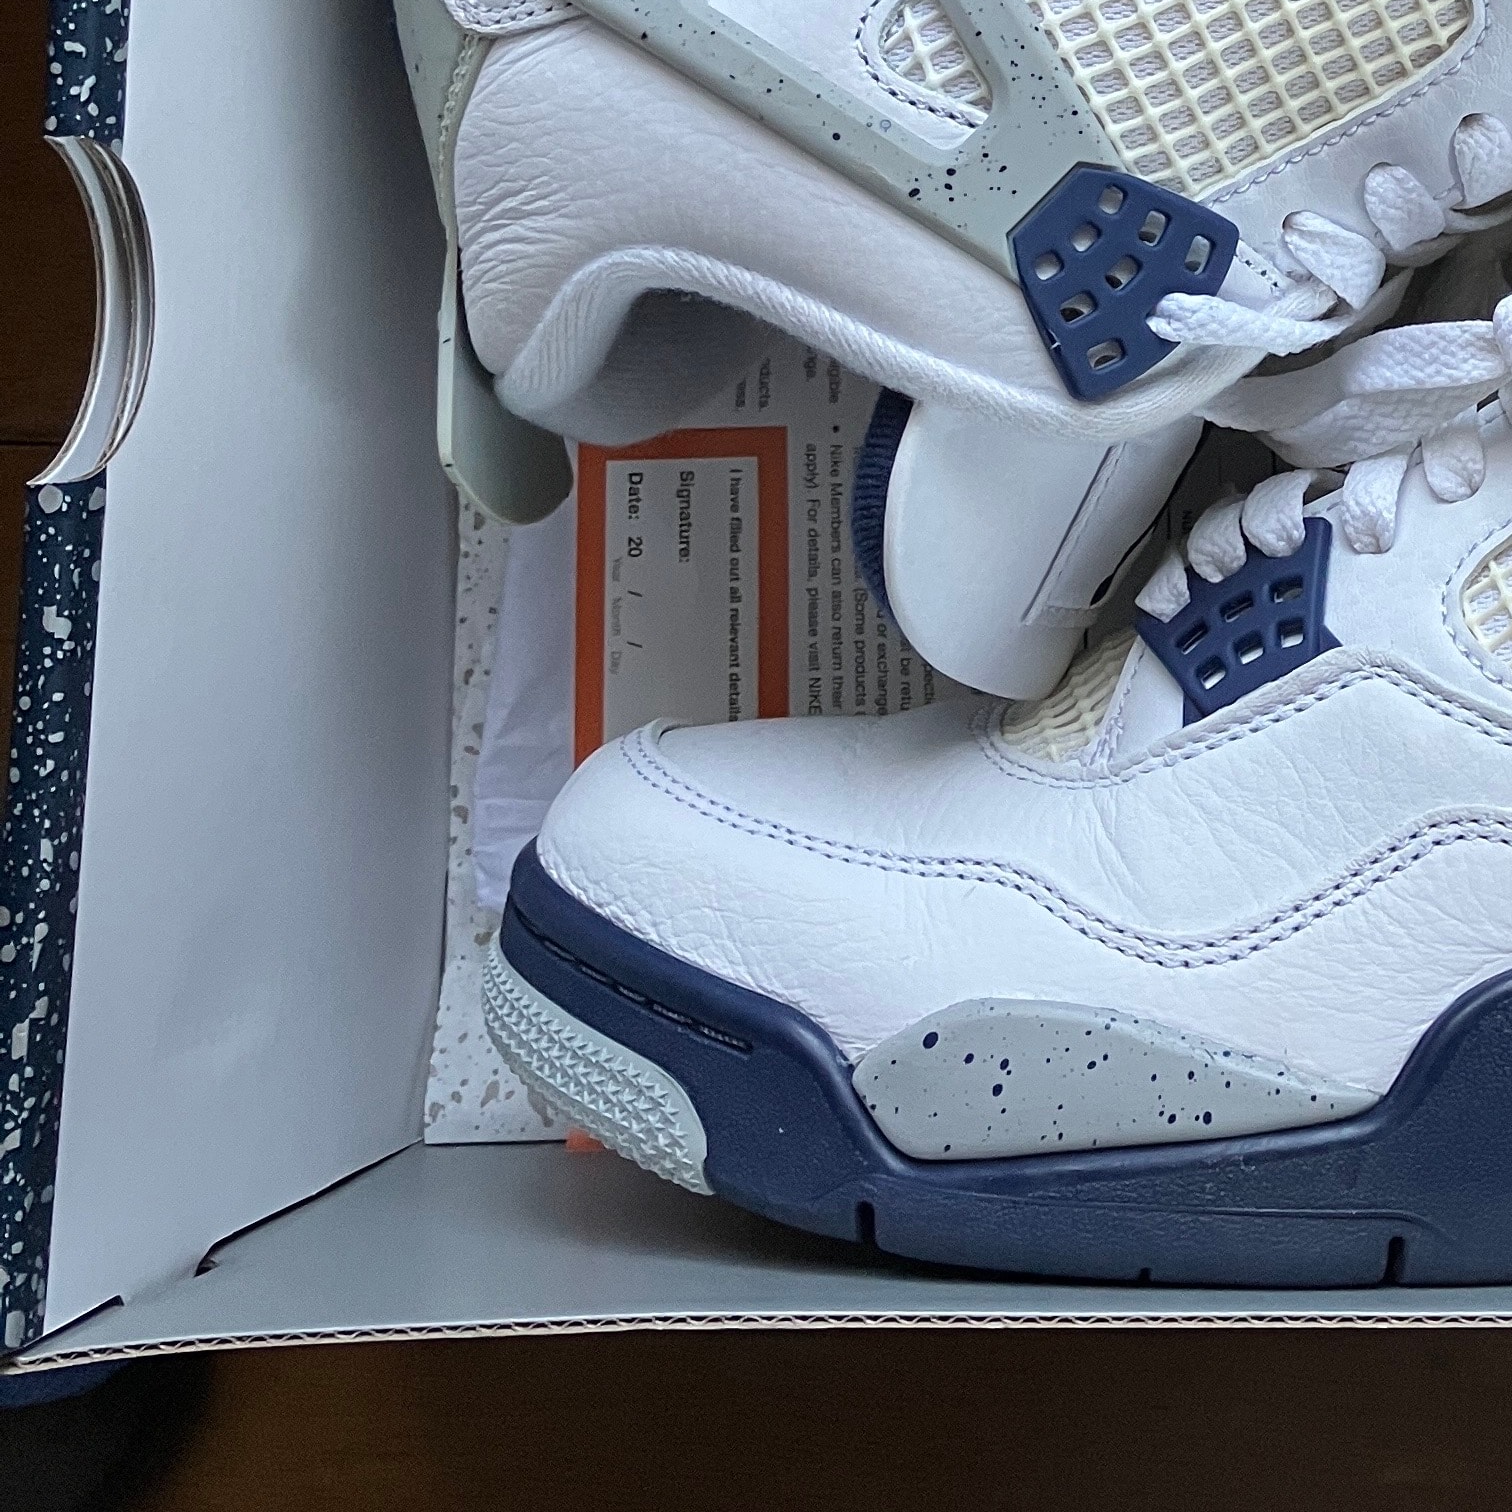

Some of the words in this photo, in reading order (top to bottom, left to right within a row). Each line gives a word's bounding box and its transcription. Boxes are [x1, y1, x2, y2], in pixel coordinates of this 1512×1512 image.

[830, 444, 844, 478] Nike
[627, 471, 644, 520] Date:
[729, 477, 742, 513] have
[806, 498, 821, 524] For
[675, 470, 696, 564] Signature:
[830, 482, 844, 553] Members
[627, 536, 644, 558] 20
[729, 517, 743, 553] filled
[729, 557, 742, 583] out
[830, 557, 842, 585] can
[729, 586, 743, 604] all
[806, 587, 820, 637] please
[830, 590, 844, 622] also
[853, 588, 869, 636] (Some
[729, 608, 743, 669] relevant
[831, 626, 844, 671] return
[877, 623, 889, 639] or
[609, 651, 623, 675] Day
[808, 642, 821, 672] visit
[853, 640, 868, 707] products
[900, 658, 912, 677] be
[729, 672, 743, 723] details
[831, 675, 844, 710] their
